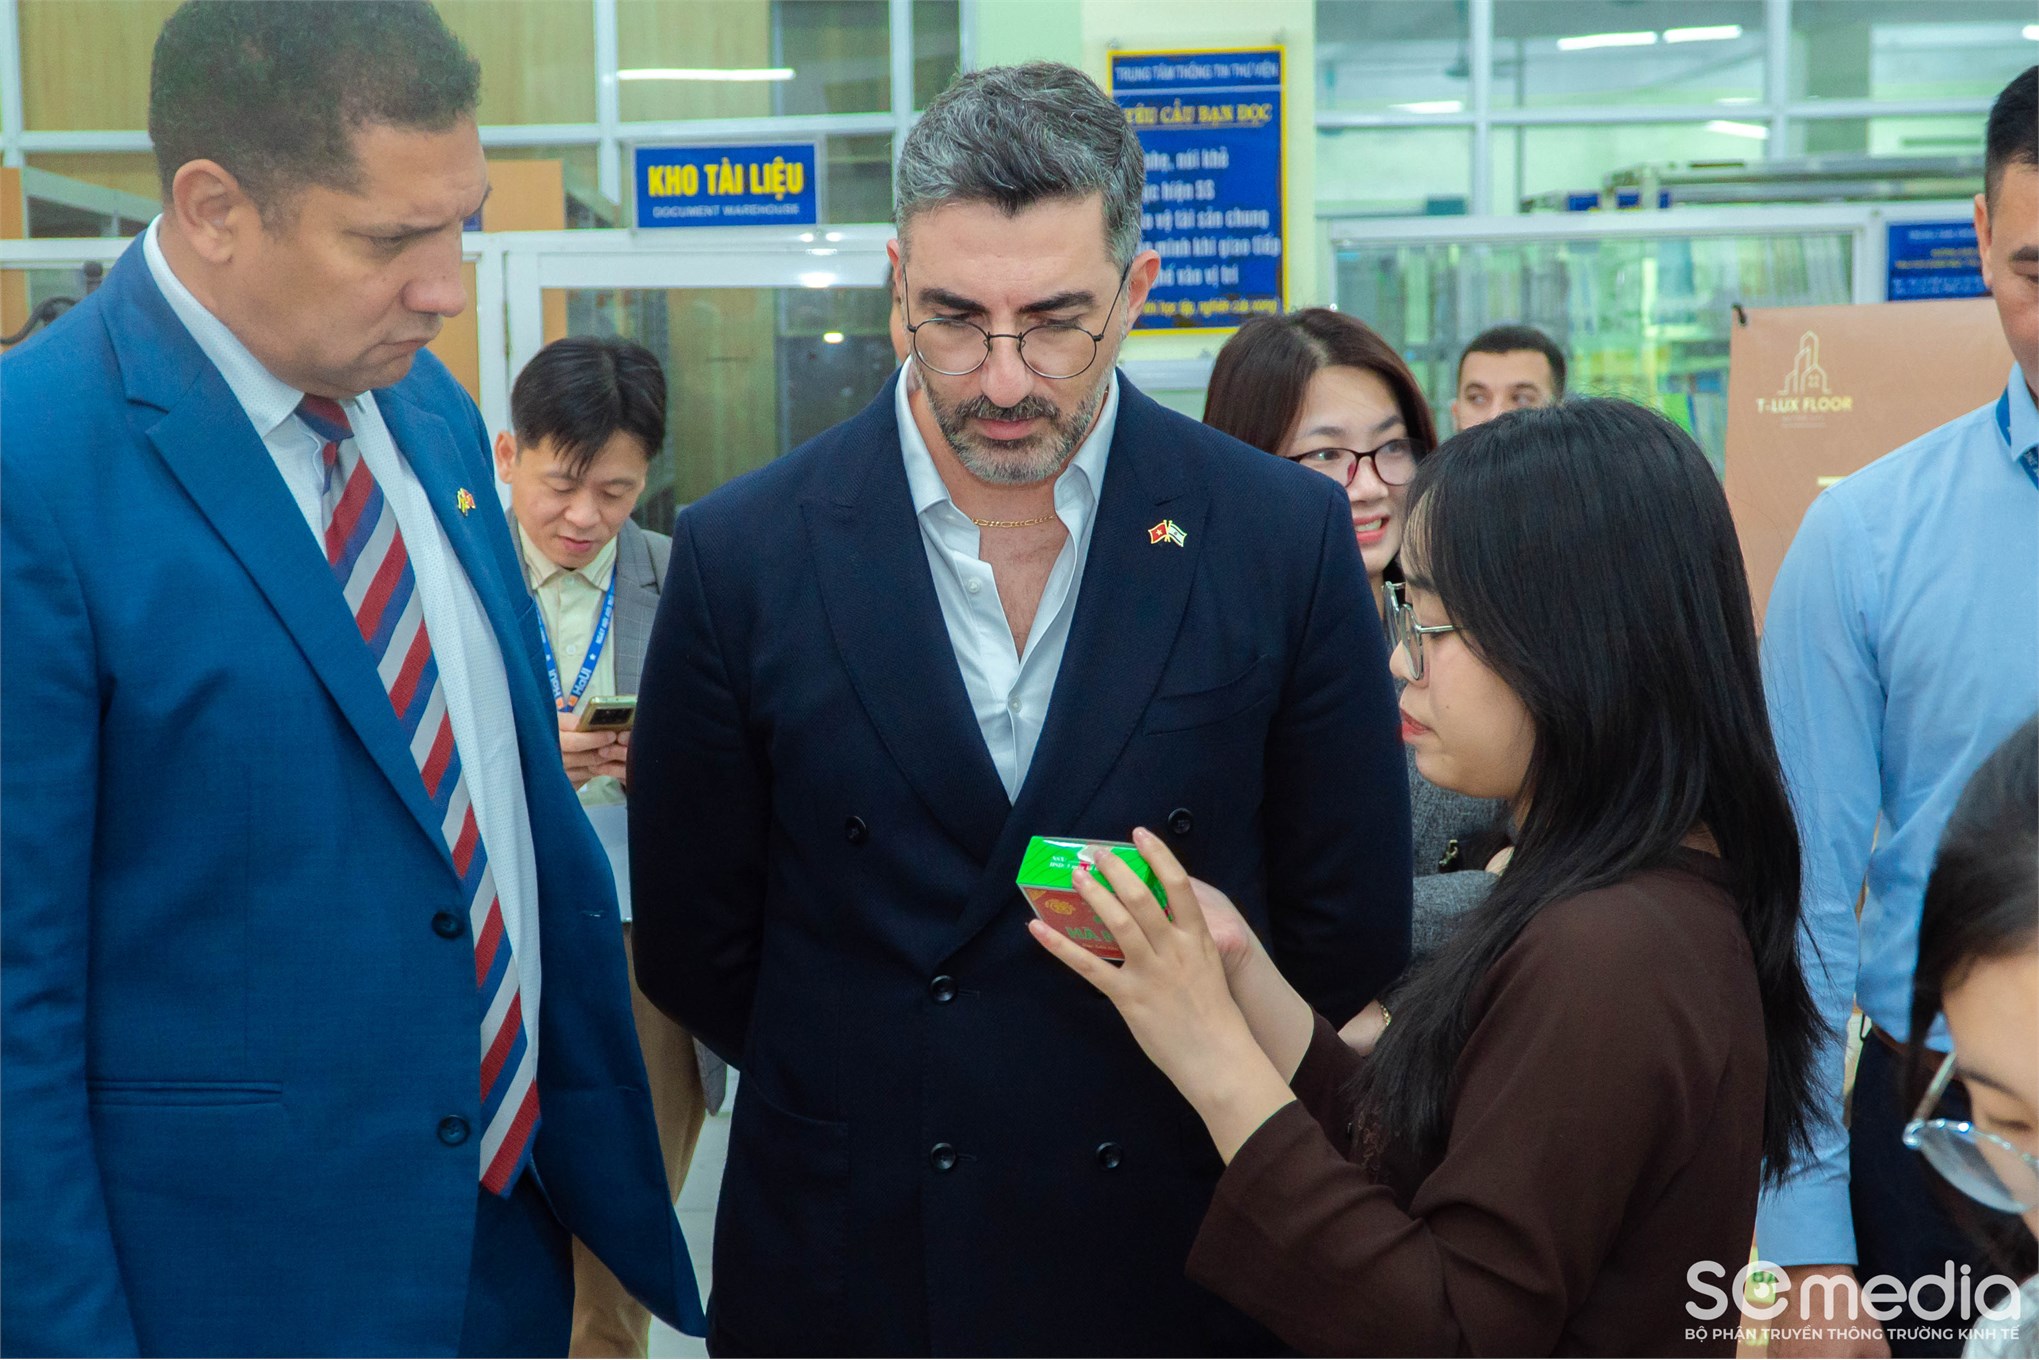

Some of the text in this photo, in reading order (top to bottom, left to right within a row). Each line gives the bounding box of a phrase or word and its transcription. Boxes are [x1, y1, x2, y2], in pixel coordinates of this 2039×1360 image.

[1115, 66, 1150, 81] TRUNG
[1199, 104, 1234, 126] BẠN
[648, 156, 804, 201] KHO TÀI LIỆU
[653, 203, 800, 218] DOCUMENT WAREHOUSE
[1225, 206, 1270, 230] chung
[1756, 396, 1854, 413] T-LUX FLOOR
[572, 667, 592, 695] HaUI
